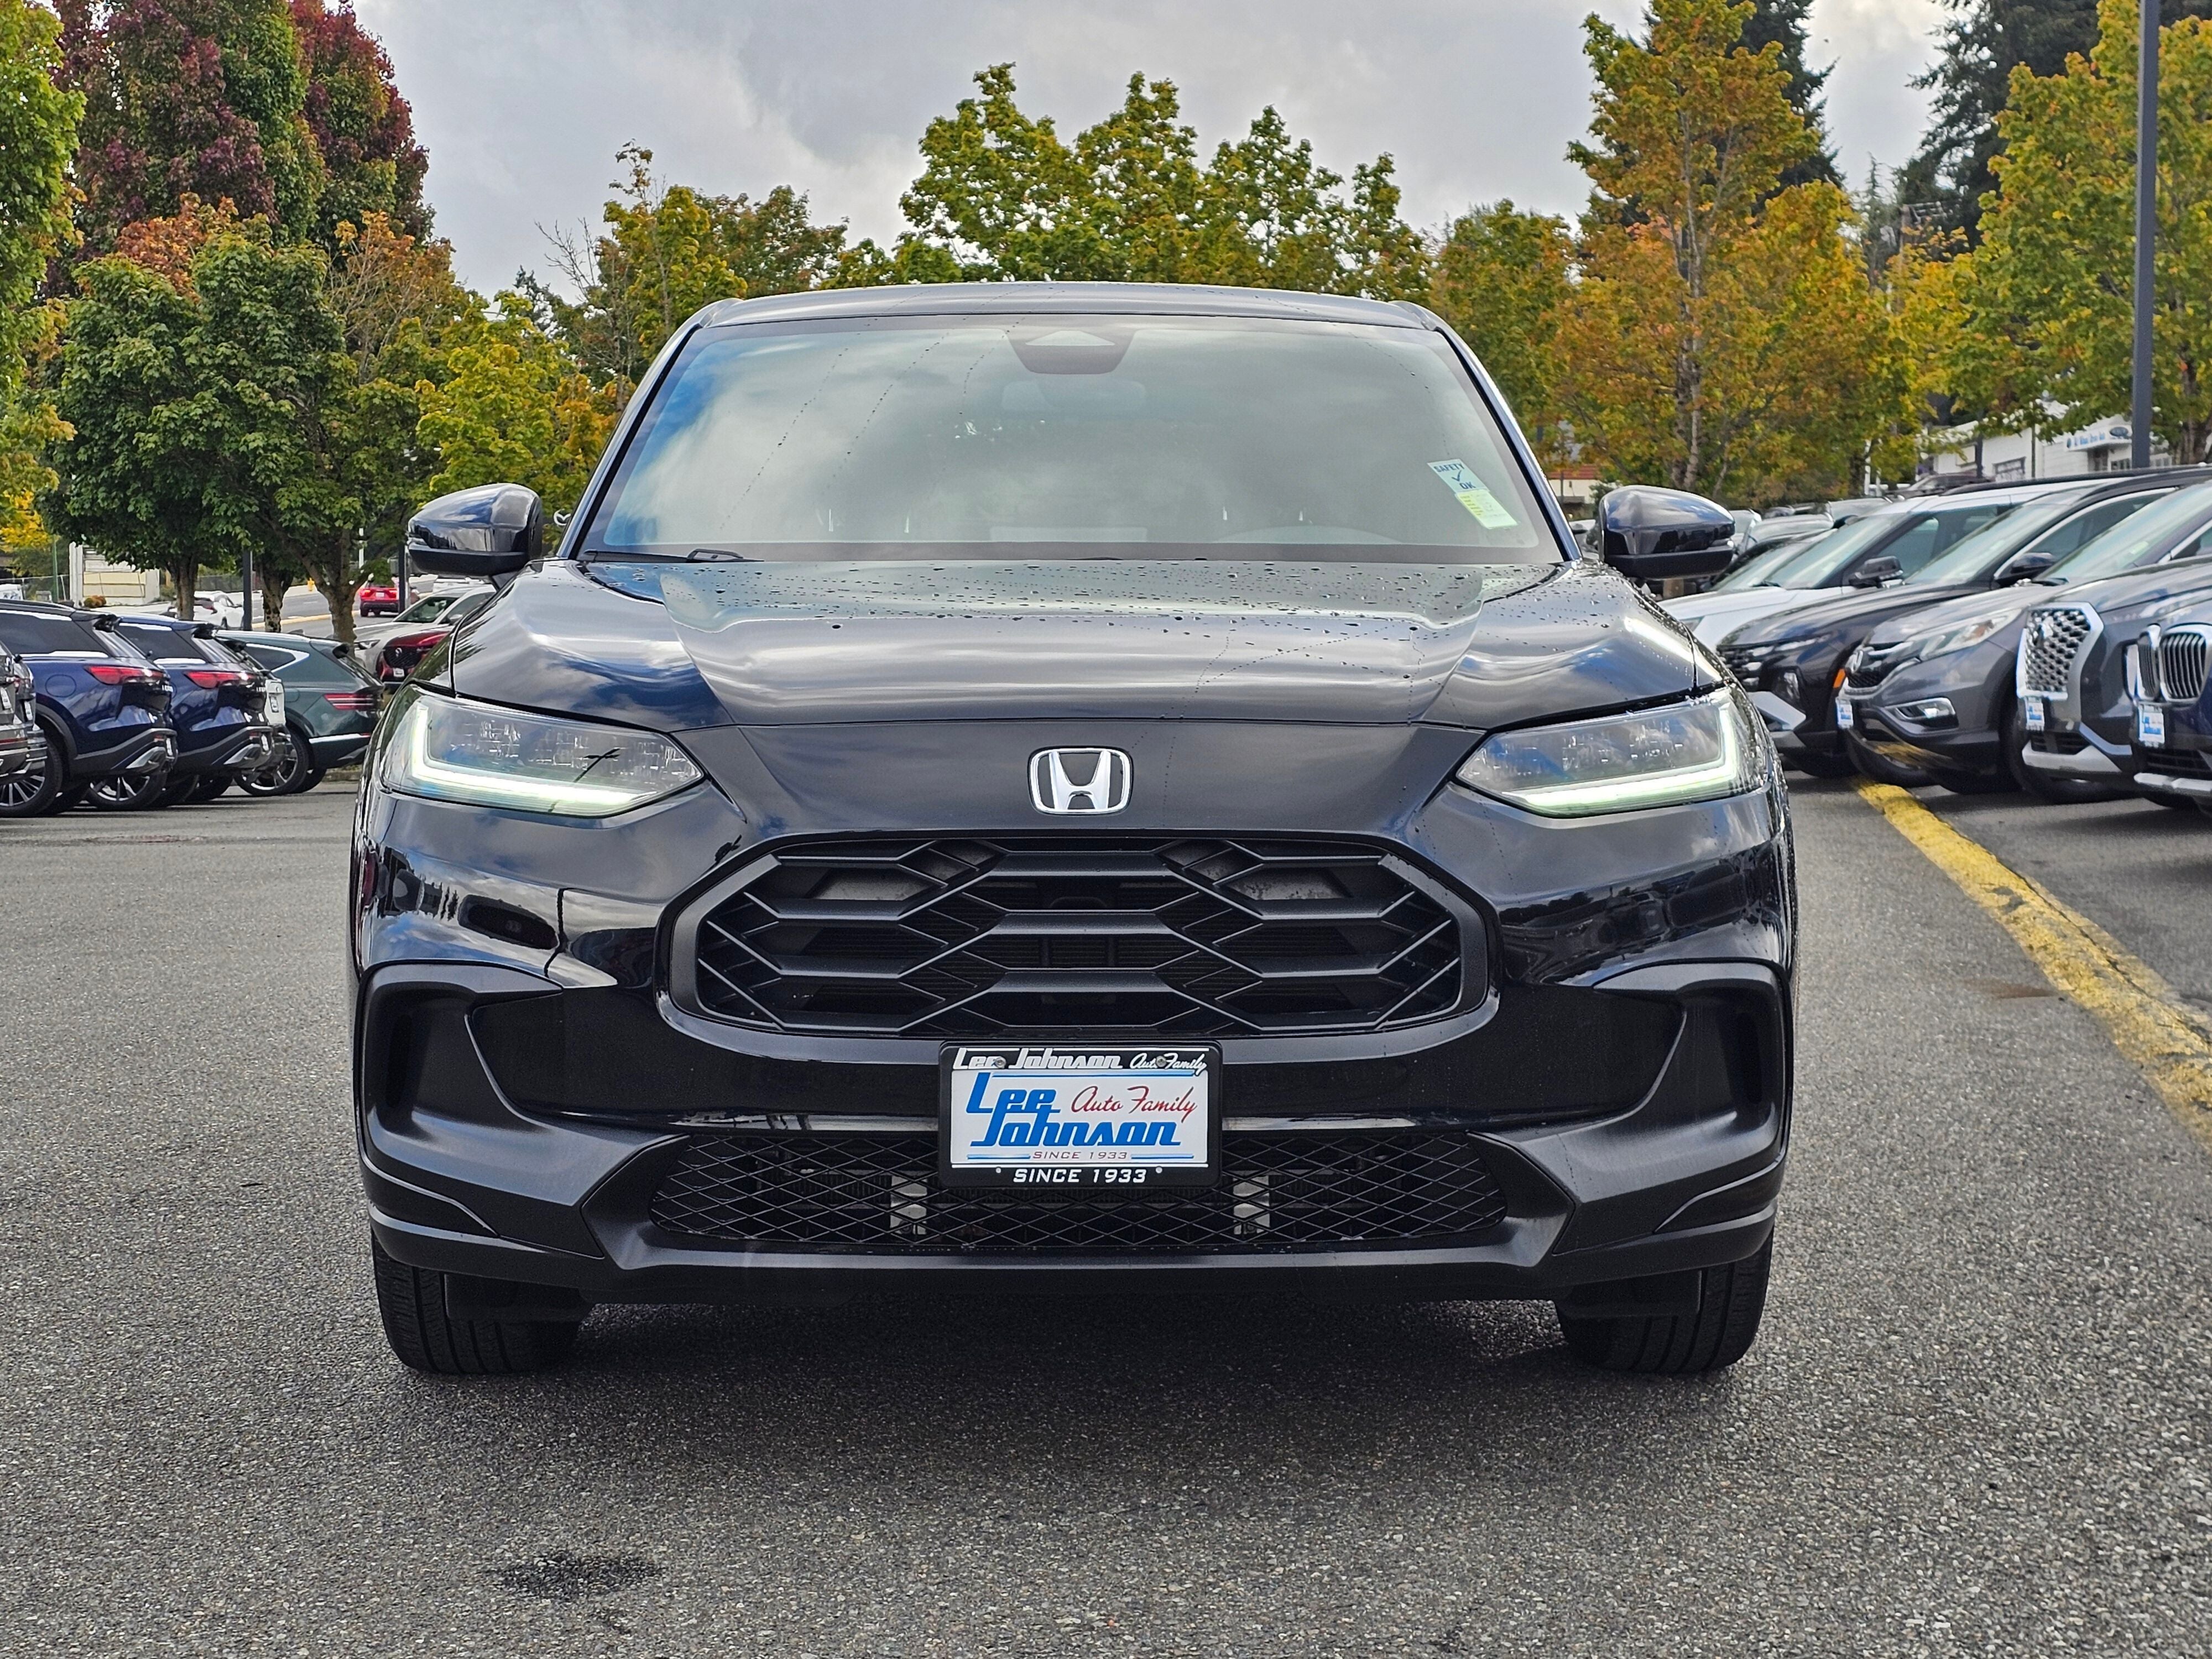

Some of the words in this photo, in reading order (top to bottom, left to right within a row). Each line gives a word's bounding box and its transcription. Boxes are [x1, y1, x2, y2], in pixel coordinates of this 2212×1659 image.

[1433, 463, 1465, 472] SAFETY
[1008, 1048, 1123, 1070] Johnson
[1130, 1053, 1166, 1069] Aut
[1162, 1053, 1207, 1076] Family
[966, 1072, 1061, 1113] Lee
[1071, 1086, 1123, 1113] Auto
[1127, 1086, 1197, 1123] Family
[971, 1105, 1181, 1146] Johnson
[1032, 1151, 1081, 1160] SINCE
[1089, 1151, 1128, 1160] 1933
[1013, 1169, 1082, 1183] SINCE
[1093, 1169, 1147, 1183] 1933
